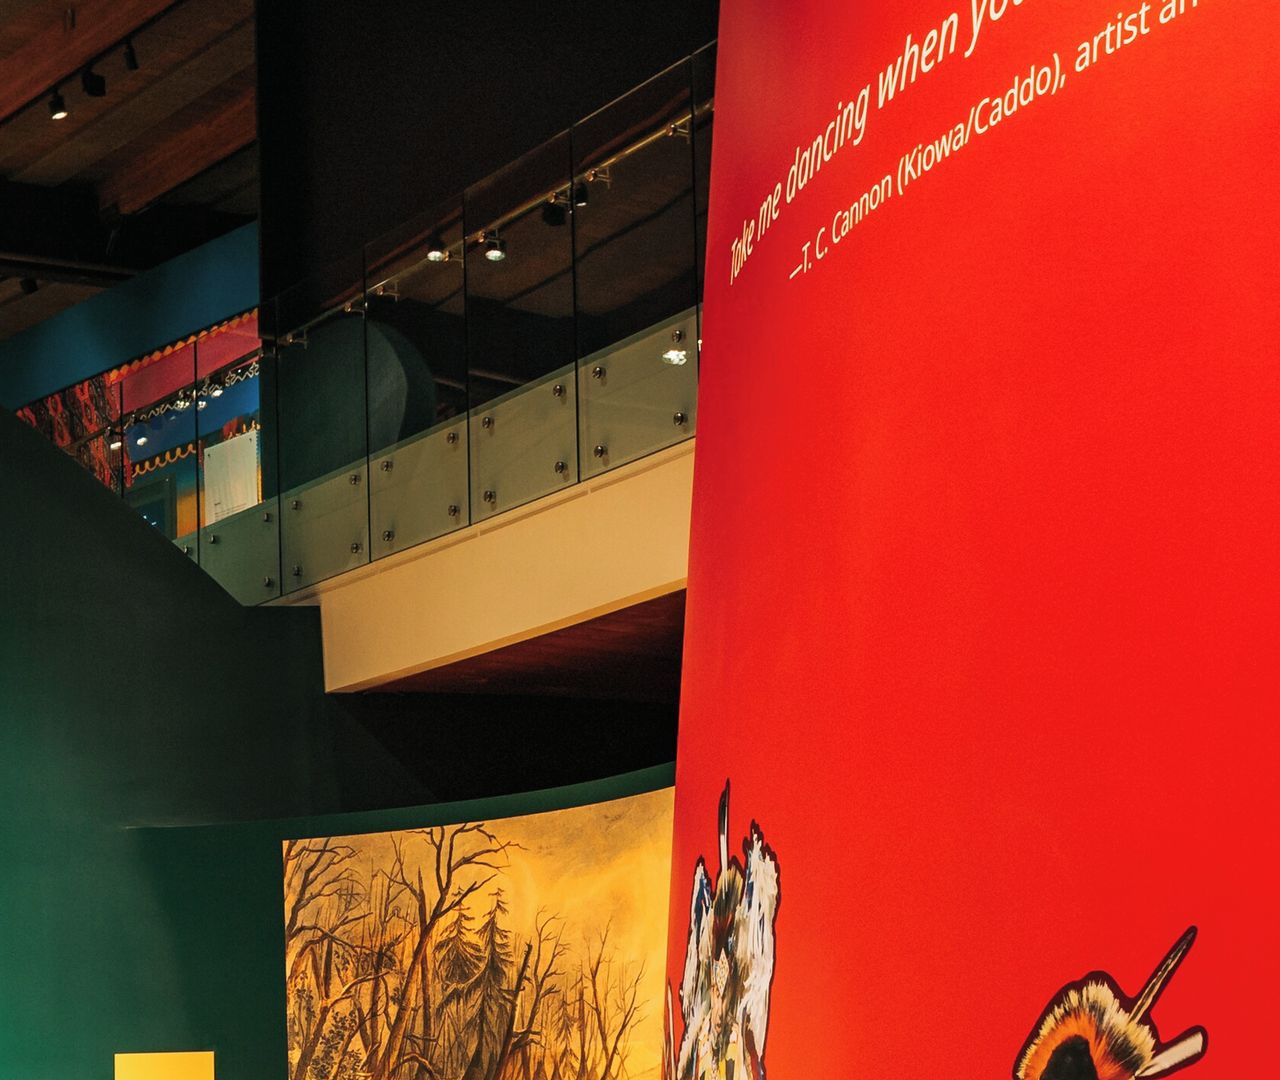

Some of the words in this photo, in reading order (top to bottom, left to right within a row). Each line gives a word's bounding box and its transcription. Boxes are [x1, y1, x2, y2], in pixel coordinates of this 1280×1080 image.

[730, 219, 755, 286] Take
[757, 182, 782, 242] me
[786, 84, 871, 204] dancing
[878, 12, 959, 109] when
[815, 226, 828, 260] C.
[832, 174, 892, 244] Cannon
[897, 52, 1066, 196] (Kiowa/Caddo),
[1074, 1, 1151, 73] artist
